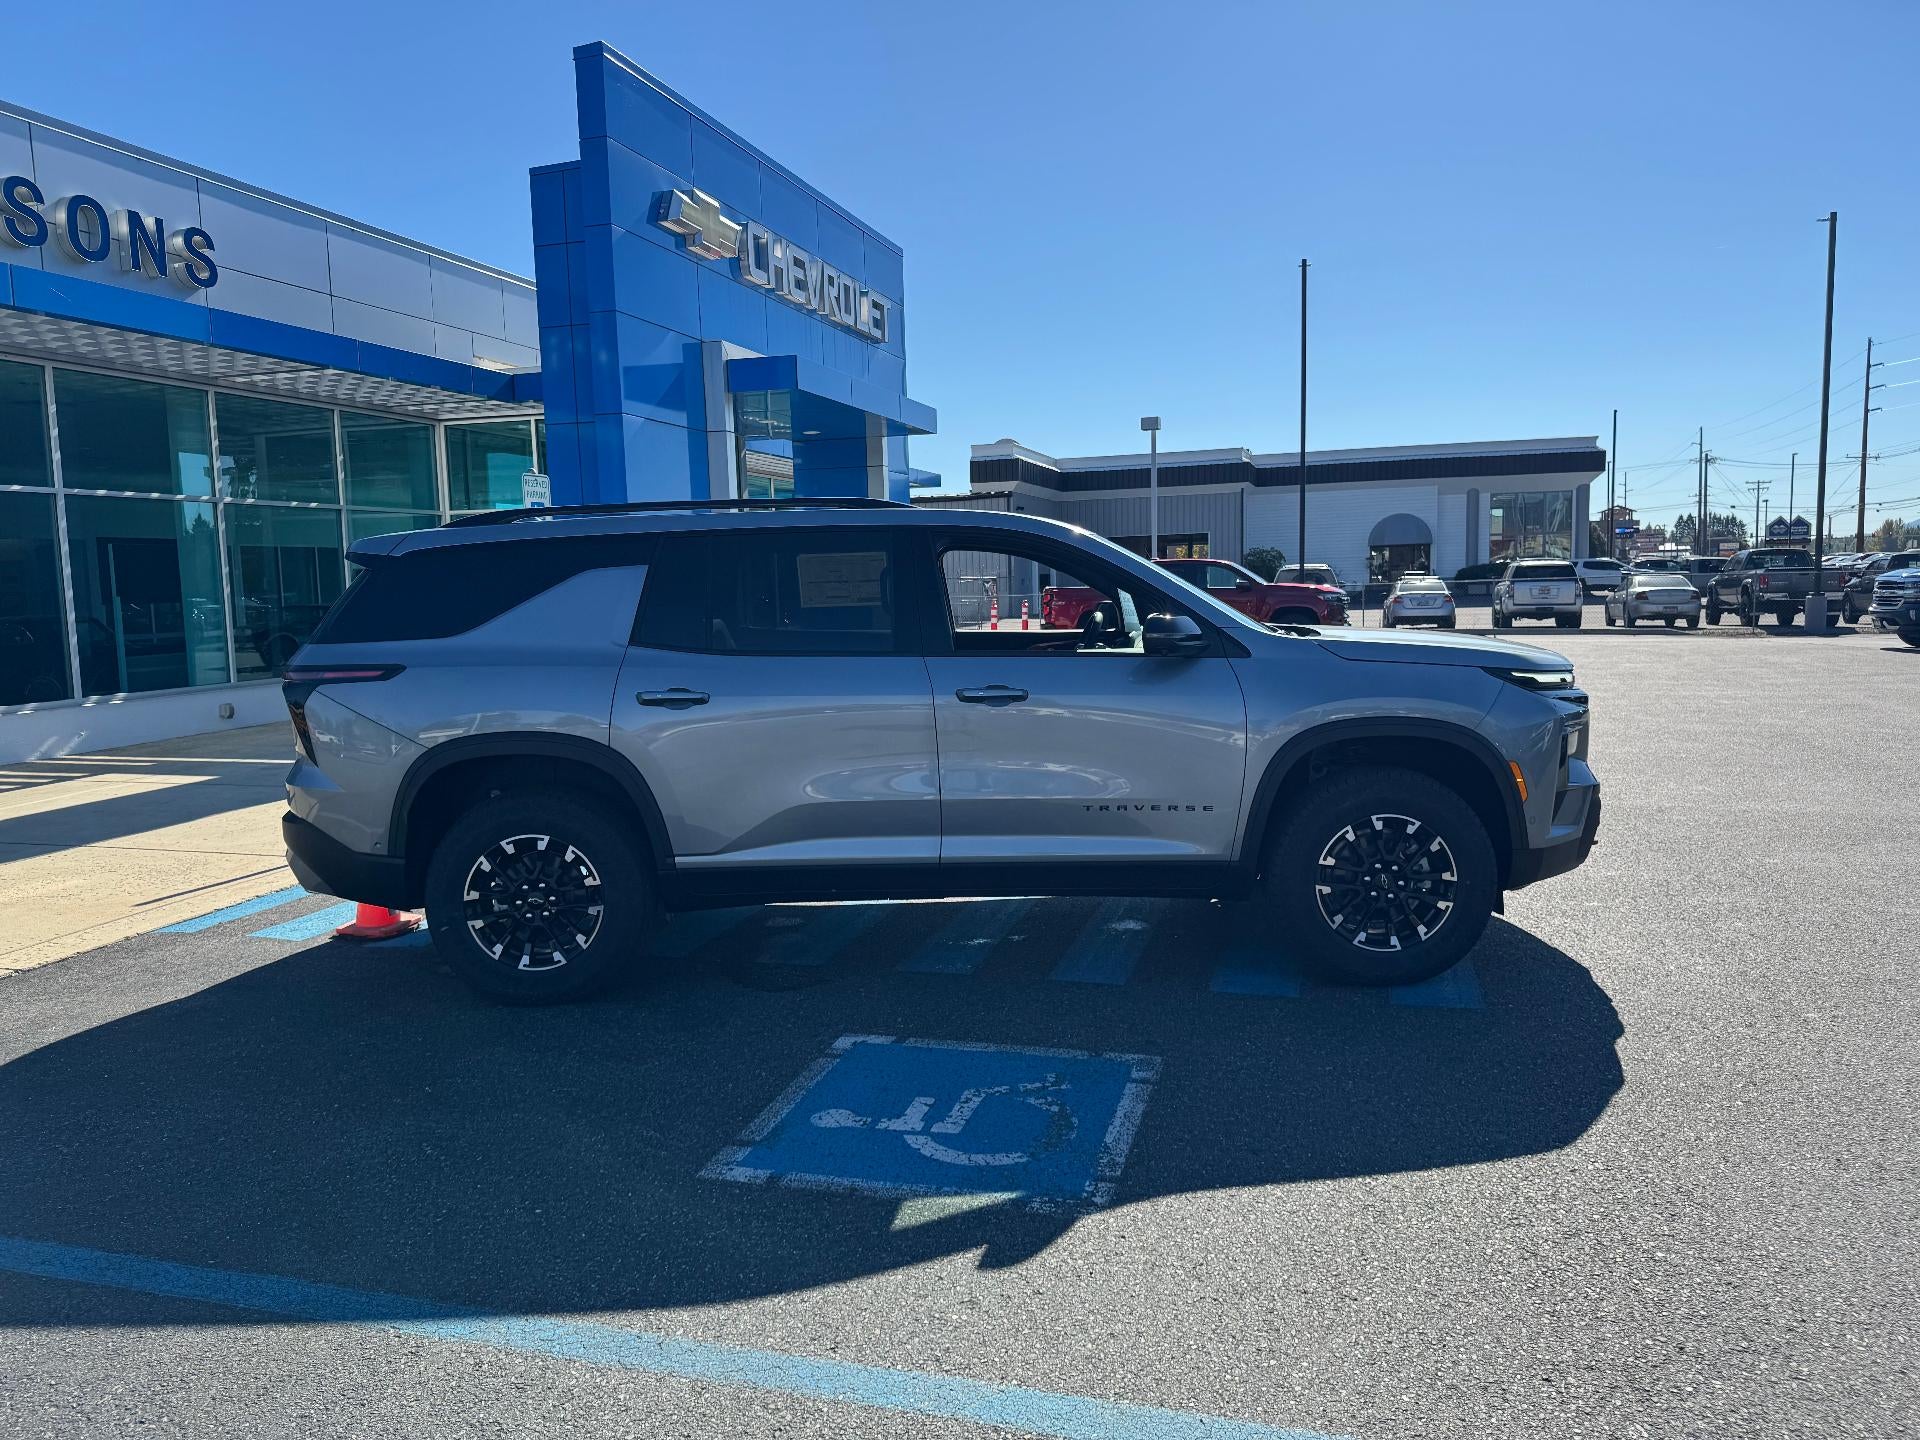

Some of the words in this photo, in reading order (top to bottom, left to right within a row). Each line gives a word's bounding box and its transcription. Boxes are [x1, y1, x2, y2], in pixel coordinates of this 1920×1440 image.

[1, 175, 218, 289] SONS
[740, 221, 890, 344] CHEVROLET
[524, 478, 548, 489] RESERVED
[526, 490, 548, 500] PARKING
[1082, 804, 1215, 812] TRAVERSE
